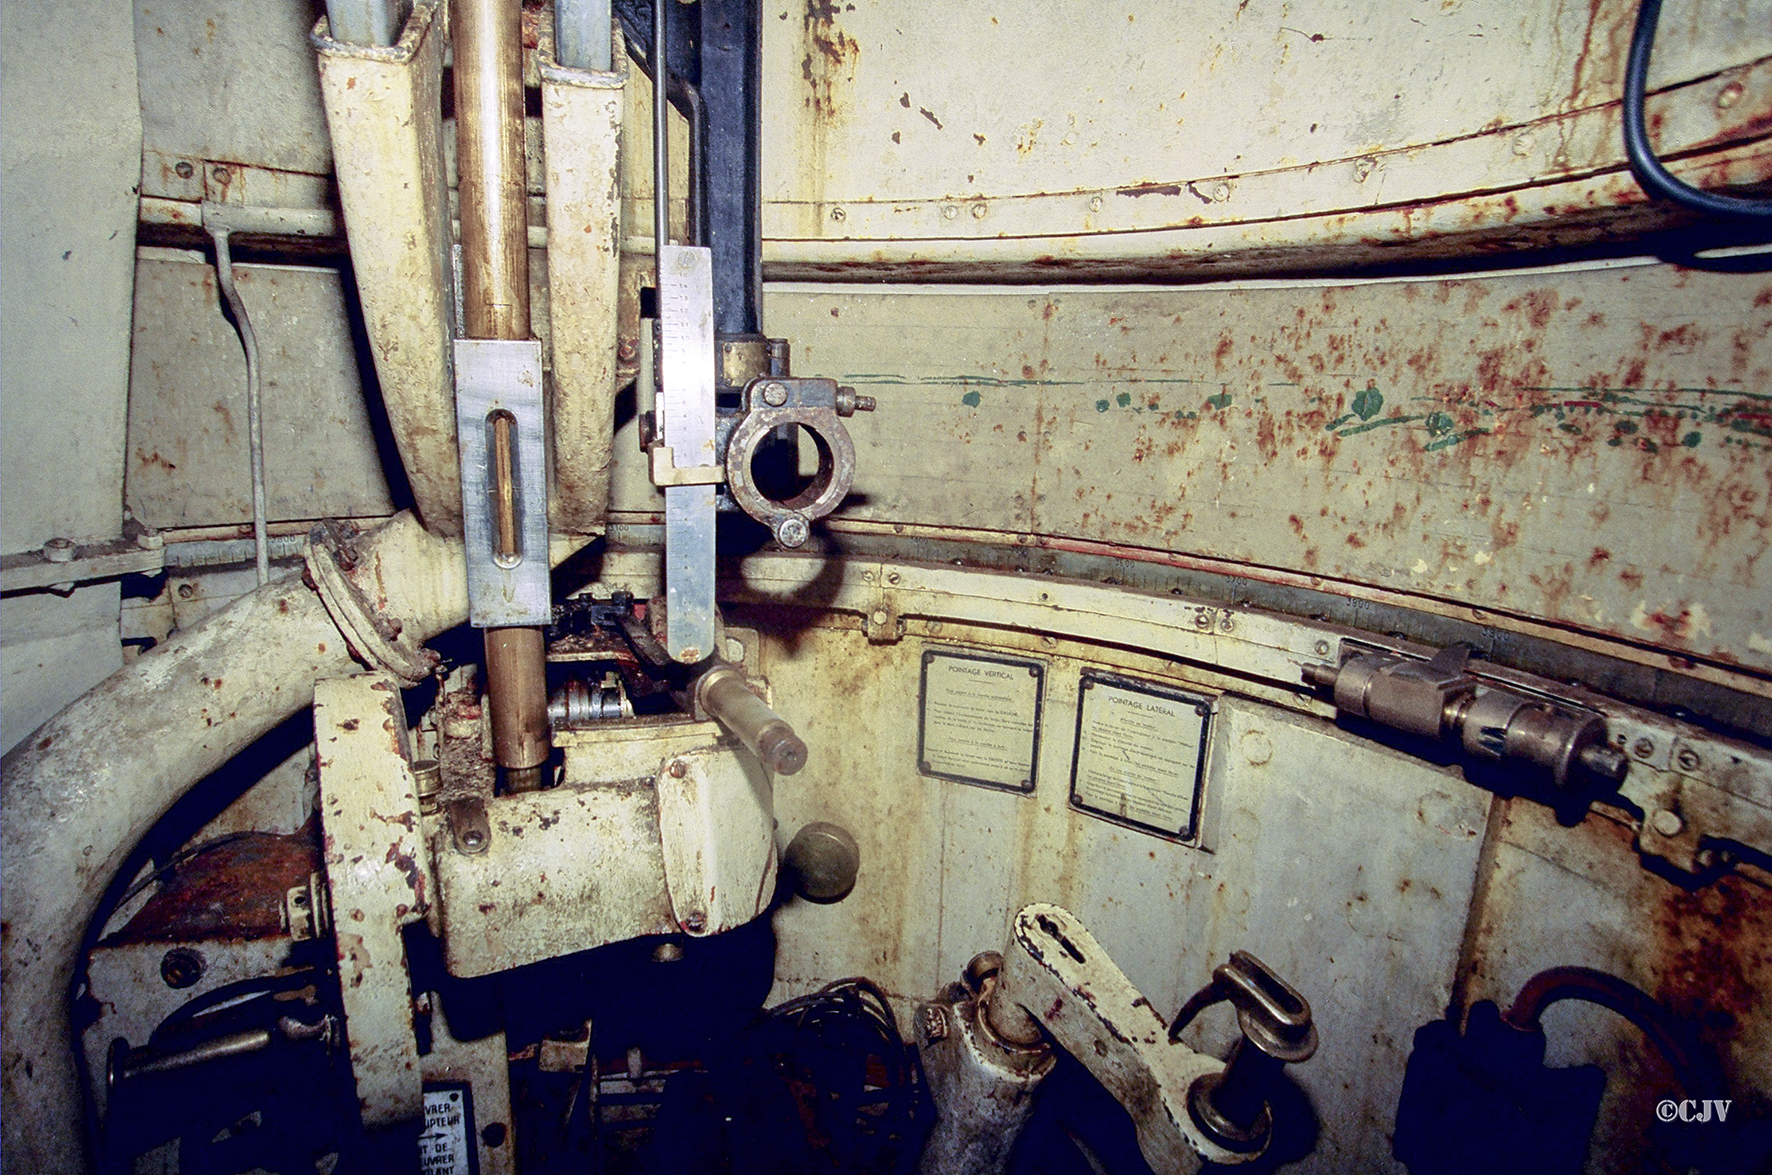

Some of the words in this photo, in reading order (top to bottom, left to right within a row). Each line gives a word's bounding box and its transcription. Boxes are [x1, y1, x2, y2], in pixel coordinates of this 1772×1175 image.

[948, 665, 981, 676] POINTAGE
[984, 670, 1014, 681] VERTICAL
[1108, 696, 1143, 710] POINTAGE
[435, 1142, 448, 1153] DE
